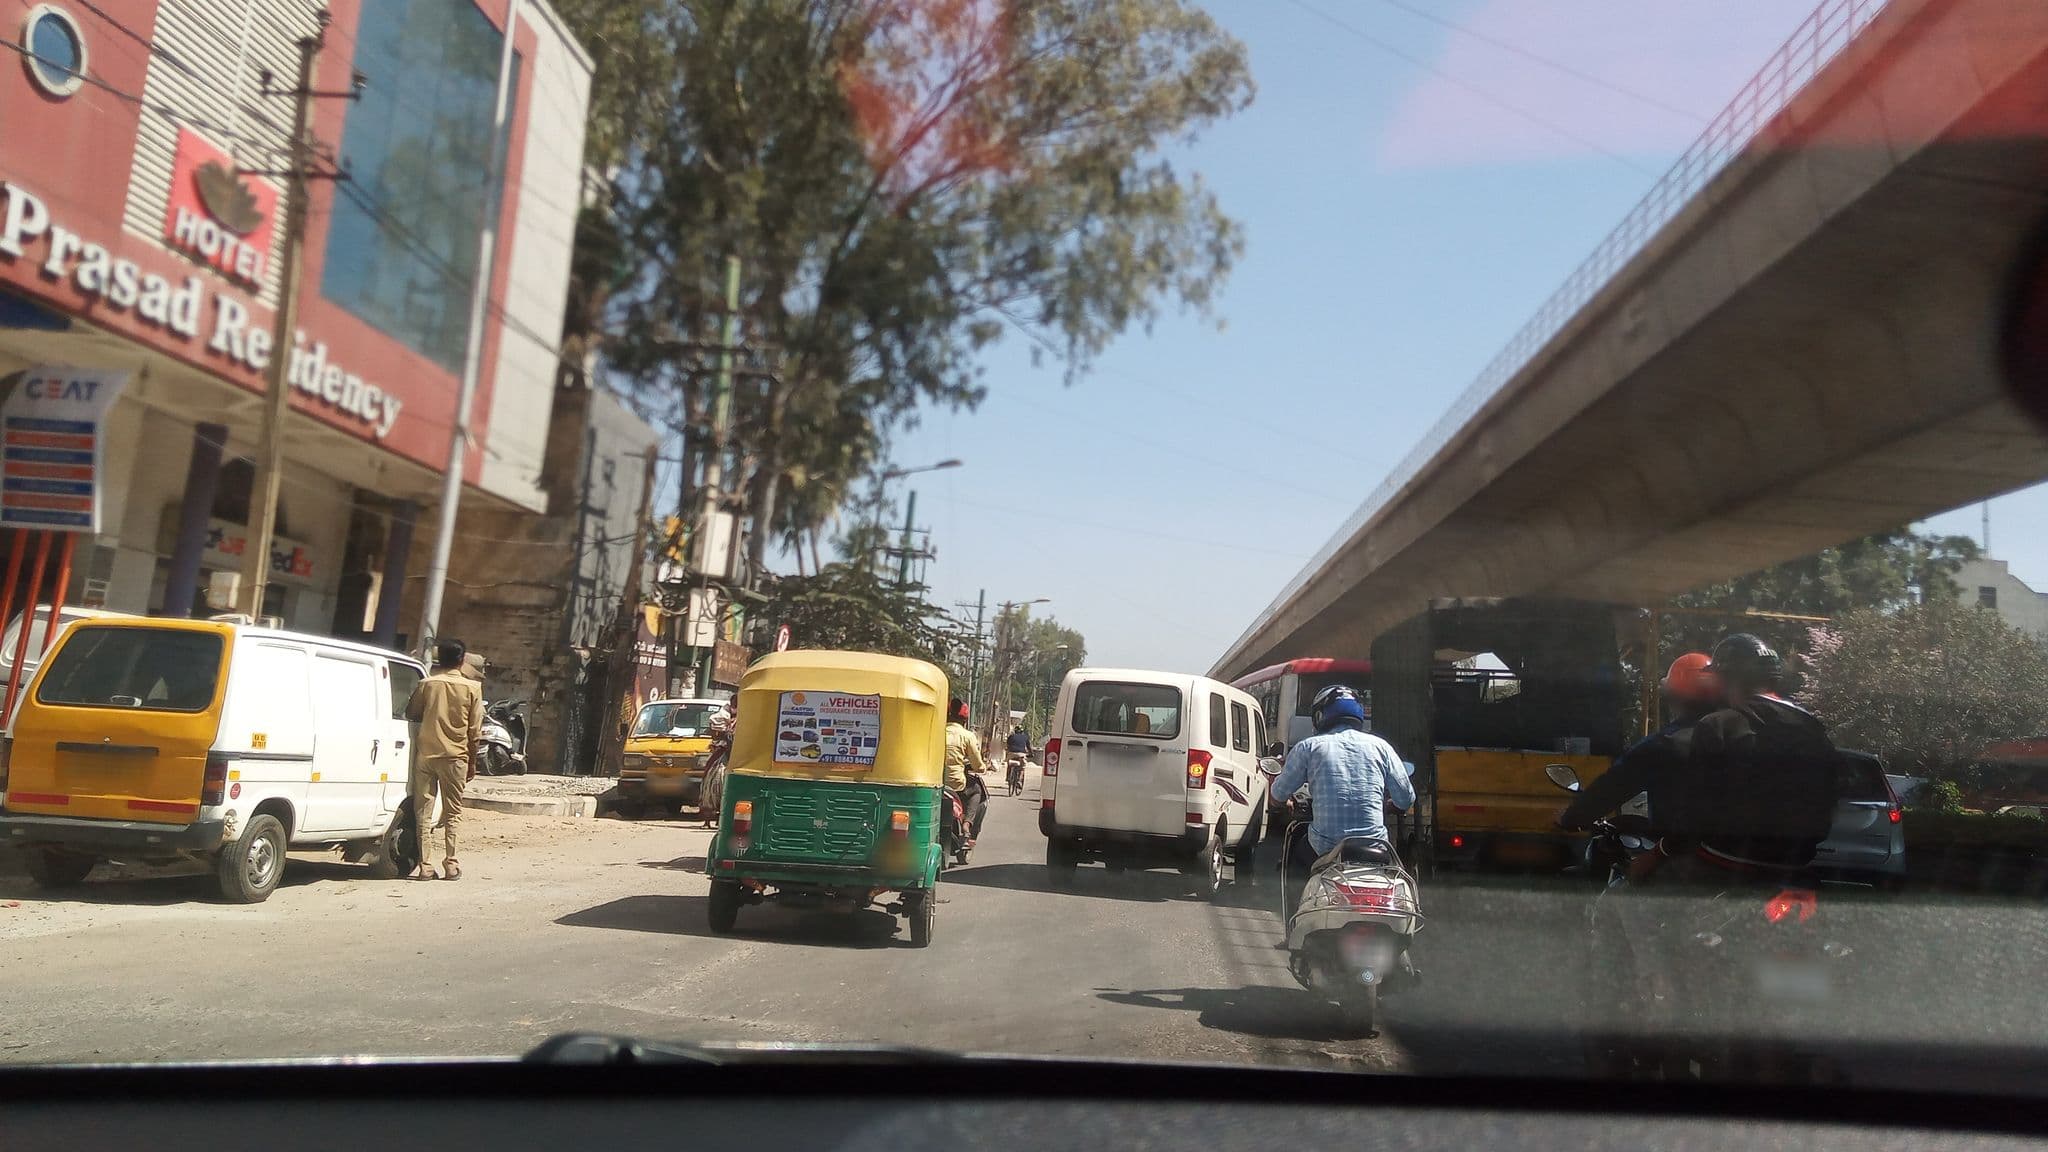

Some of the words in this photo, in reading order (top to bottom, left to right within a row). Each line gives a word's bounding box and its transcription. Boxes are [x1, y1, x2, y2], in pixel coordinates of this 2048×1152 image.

[174, 207, 266, 285] HOTEL
[0, 181, 202, 337] Prasad
[210, 293, 402, 438] Reidency
[25, 377, 99, 401] CEAT
[829, 697, 878, 708] VEHICLES
